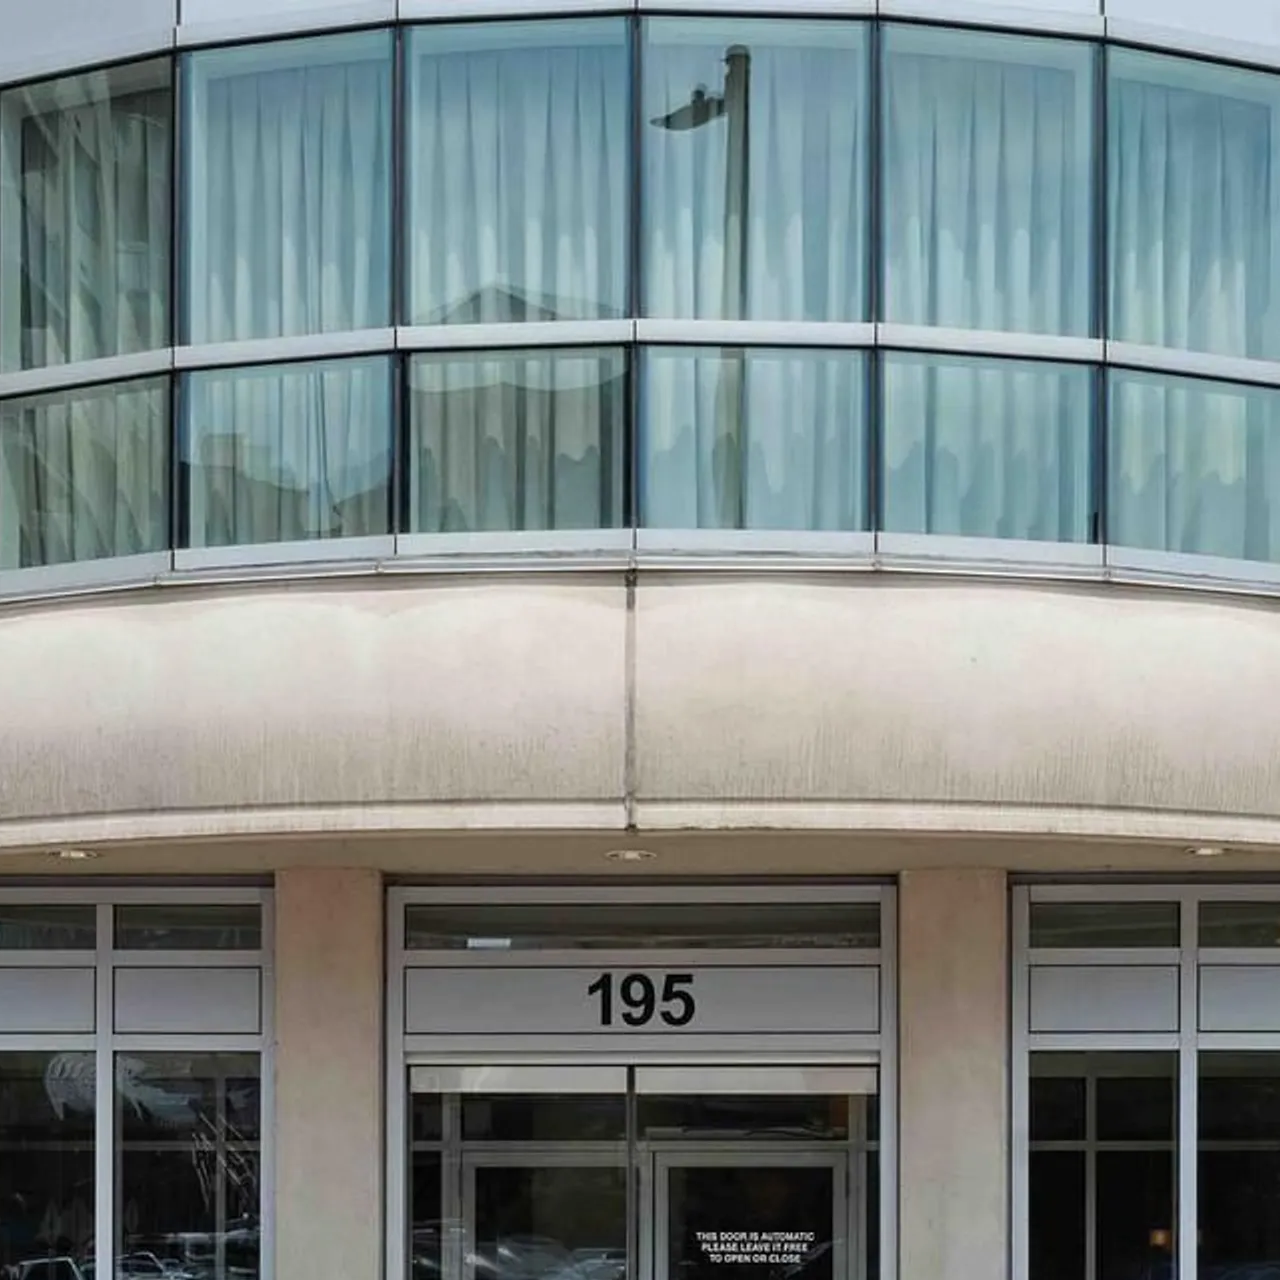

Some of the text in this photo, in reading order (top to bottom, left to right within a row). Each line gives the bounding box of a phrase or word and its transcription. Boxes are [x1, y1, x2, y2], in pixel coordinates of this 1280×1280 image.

[588, 973, 695, 1026] 195
[696, 1231, 815, 1241] THIS DOOR IS AUTOMATIC
[701, 1242, 808, 1252] PLEASE LEAVE IT FREE
[709, 1253, 801, 1263] TO OPEN OR CLOSE
